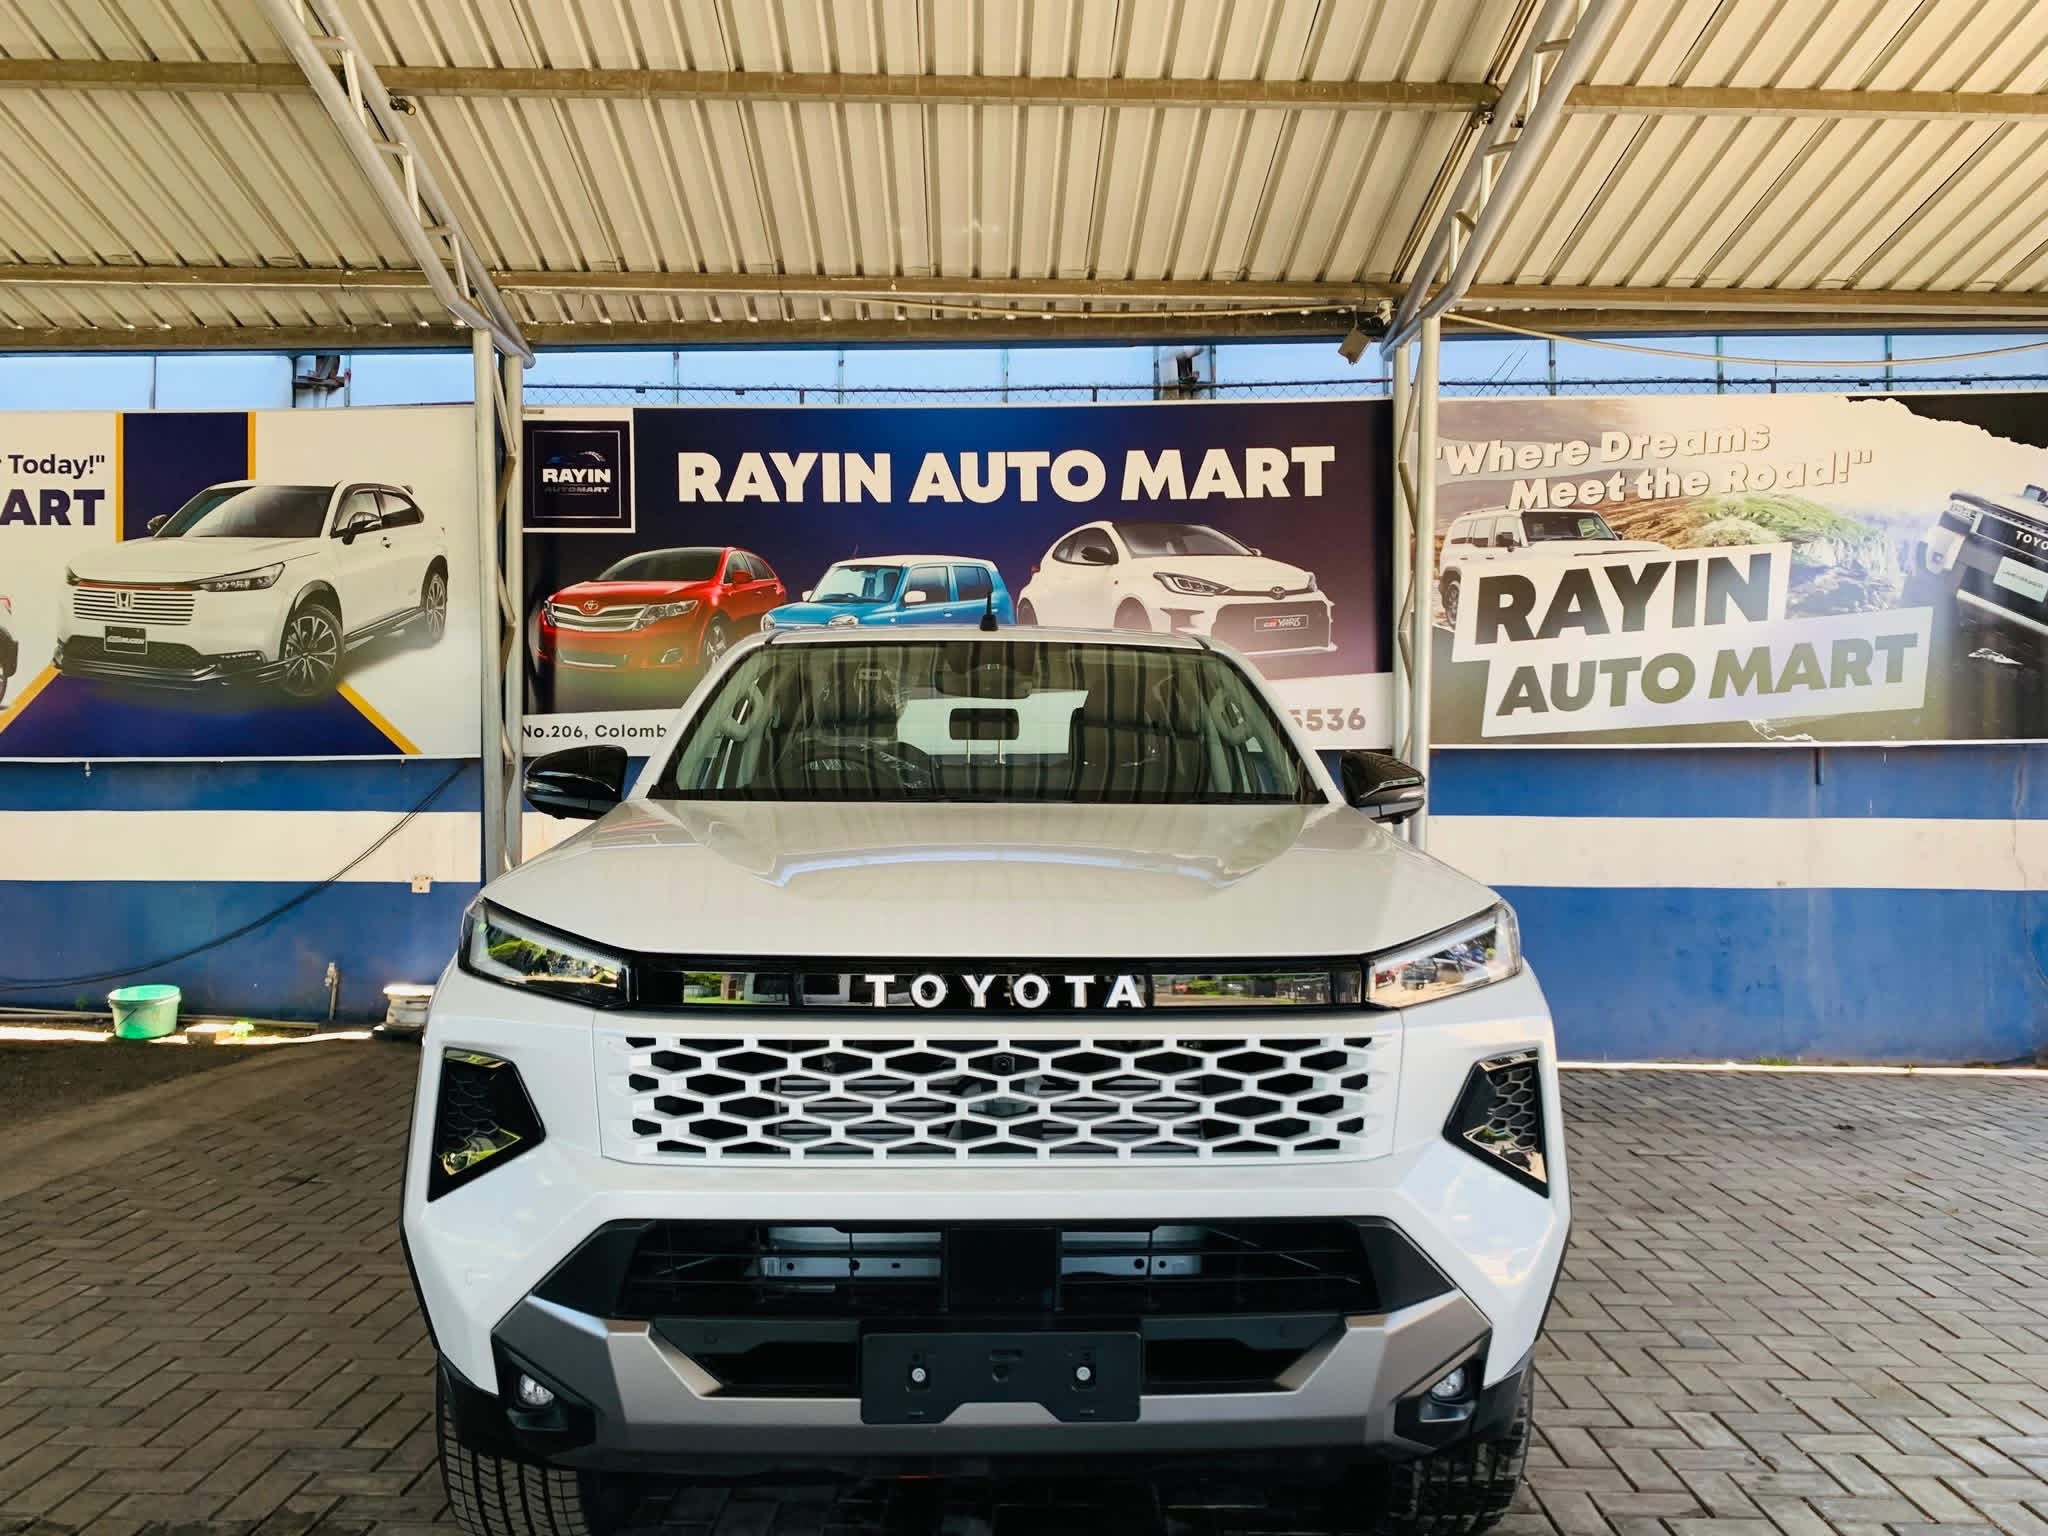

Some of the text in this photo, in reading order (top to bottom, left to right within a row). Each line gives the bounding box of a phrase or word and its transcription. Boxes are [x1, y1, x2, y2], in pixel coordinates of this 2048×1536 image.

[1601, 424, 1771, 463] Dreams
[8, 453, 105, 479] Today!"
[542, 468, 611, 483] RAYIN
[678, 445, 1336, 503] RAYIN AUTO MART
[1506, 448, 1873, 511] Meet the Road!"
[0, 489, 105, 526] ART
[1475, 553, 1772, 646] RAYIN
[1496, 632, 1918, 717] AUTO MART
[522, 724, 667, 740] No.206, Colomb
[864, 973, 1146, 1009] TOYOTA
